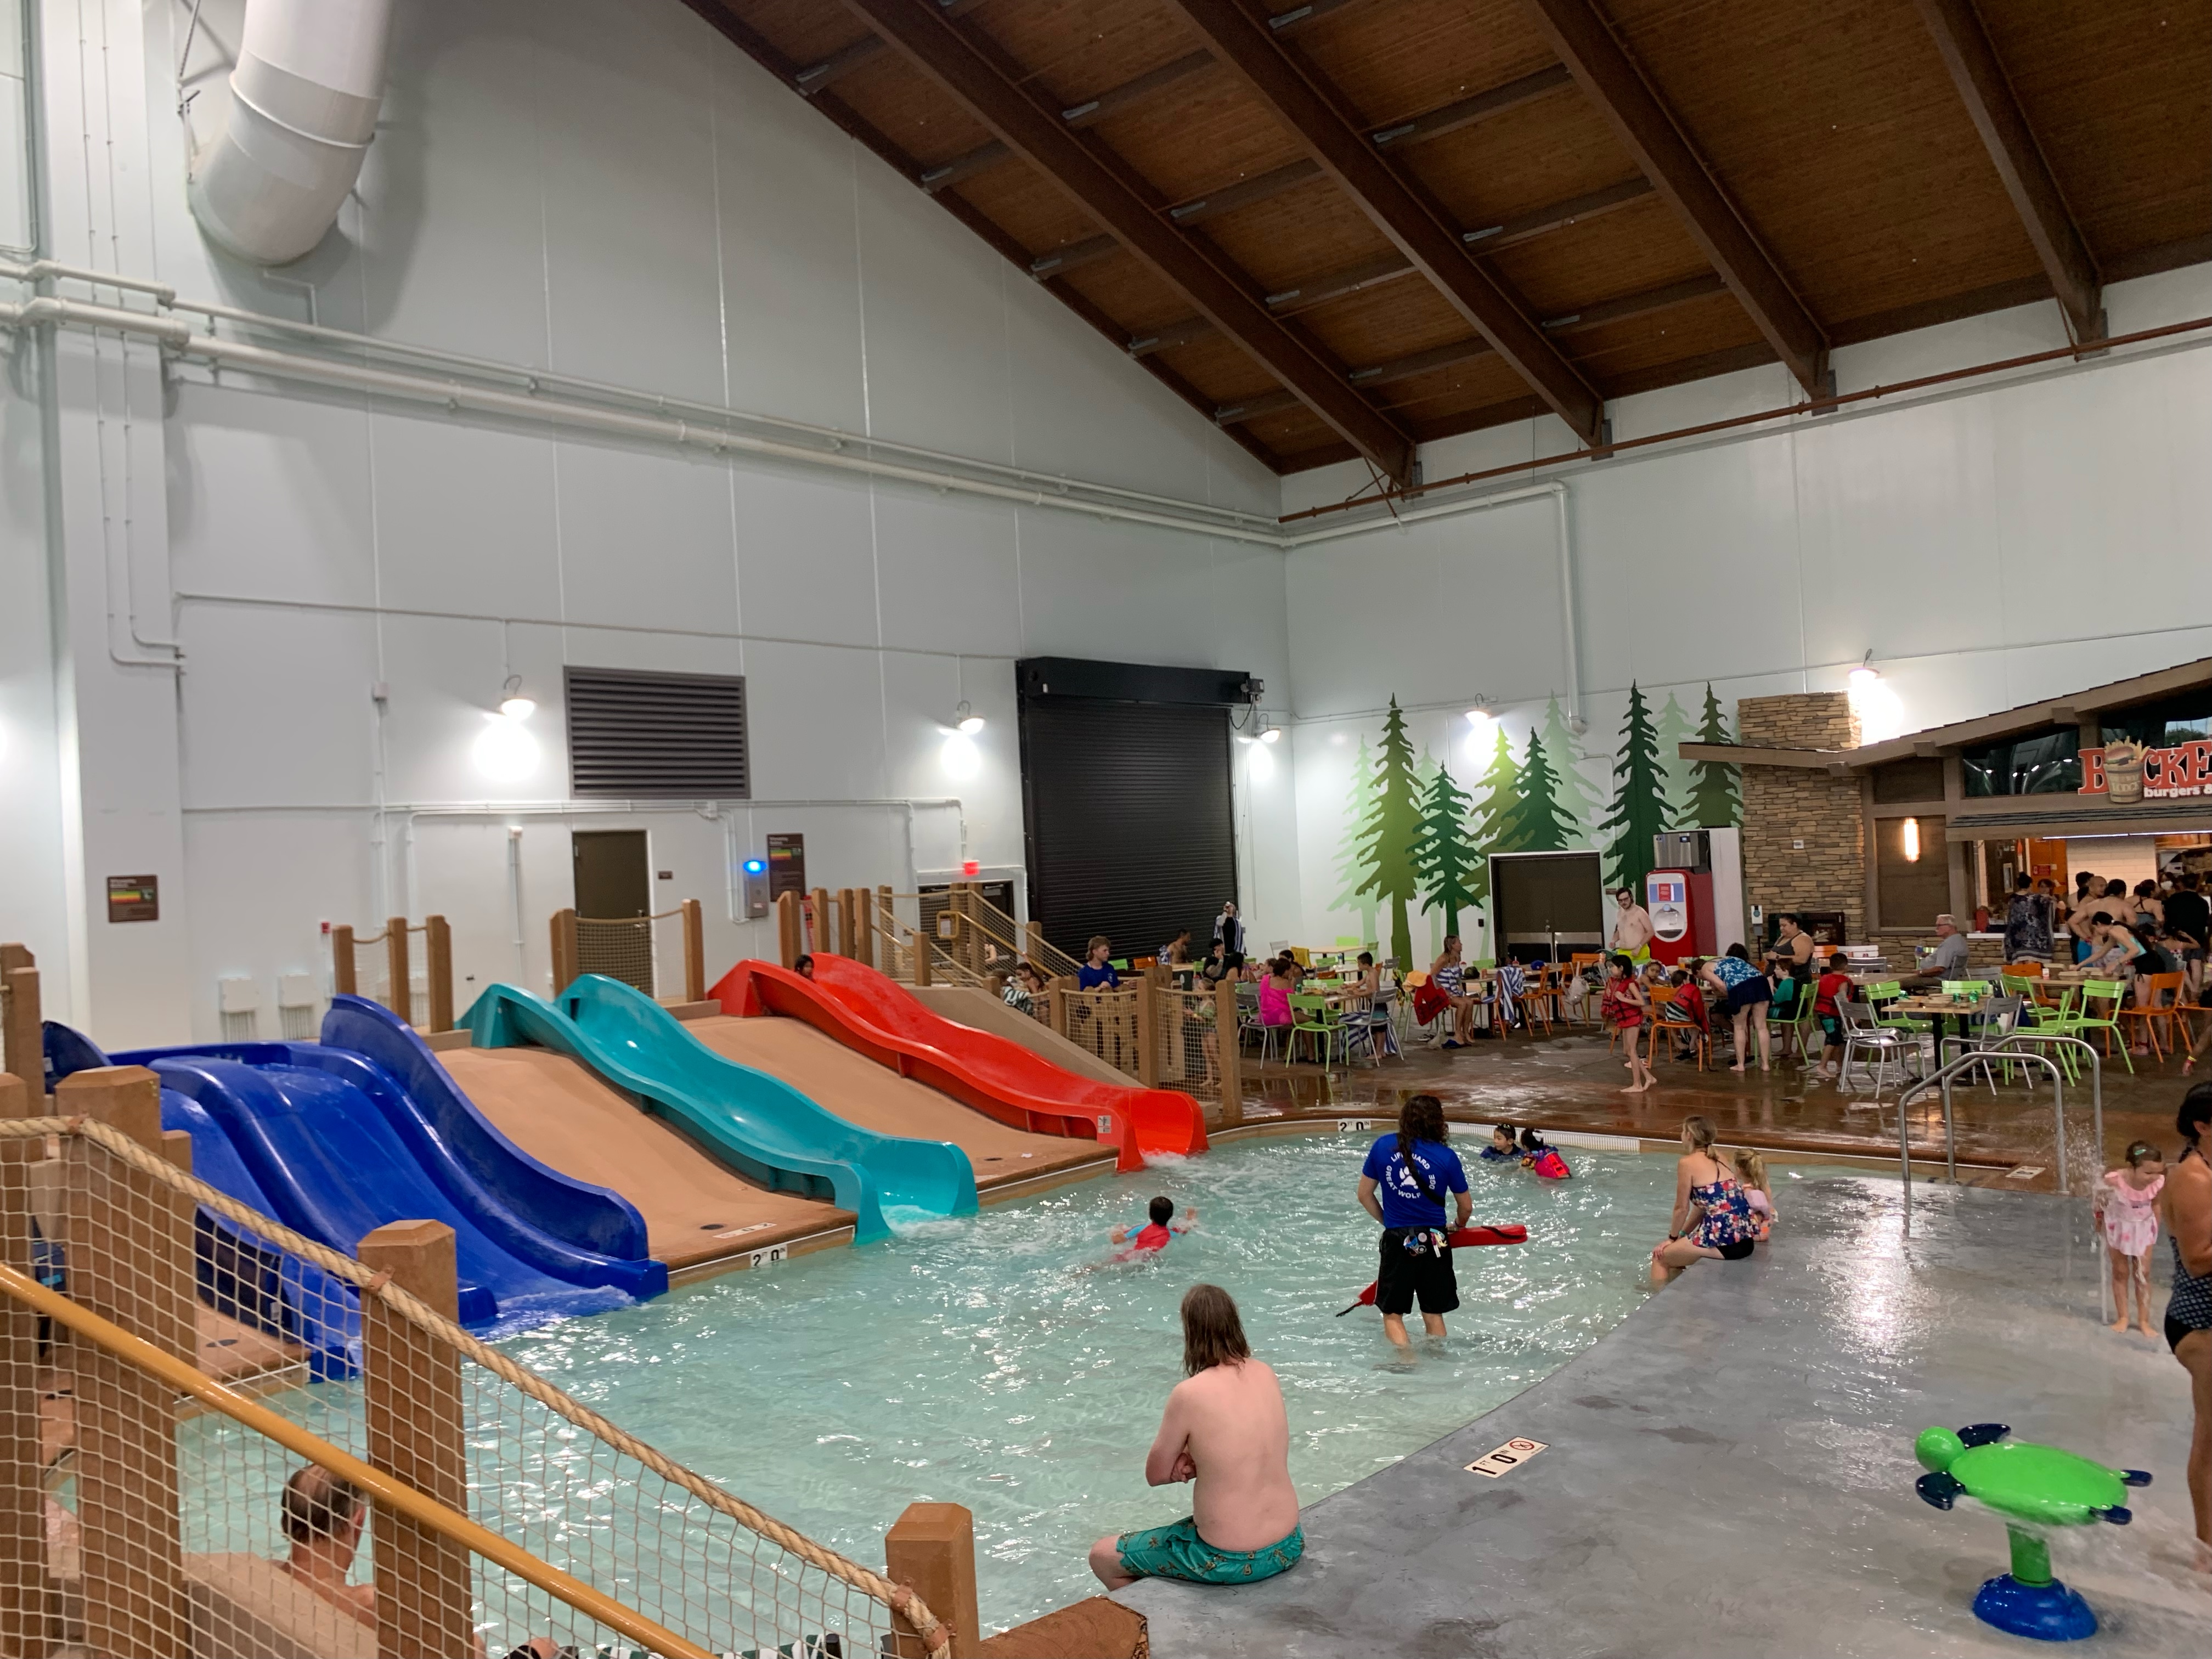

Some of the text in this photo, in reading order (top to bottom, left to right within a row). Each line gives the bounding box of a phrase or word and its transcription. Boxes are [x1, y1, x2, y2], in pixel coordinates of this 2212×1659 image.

[2143, 786, 2200, 798] burgers
[1340, 1122, 1347, 1132] 2
[1356, 1121, 1364, 1130] 0
[1385, 1165, 1398, 1190] GREAT
[1398, 1189, 1421, 1199] WOLF
[753, 1254, 761, 1267] 2
[771, 1249, 780, 1261] 0
[1472, 1466, 1497, 1475] 1
[1491, 1454, 1517, 1464] 0
